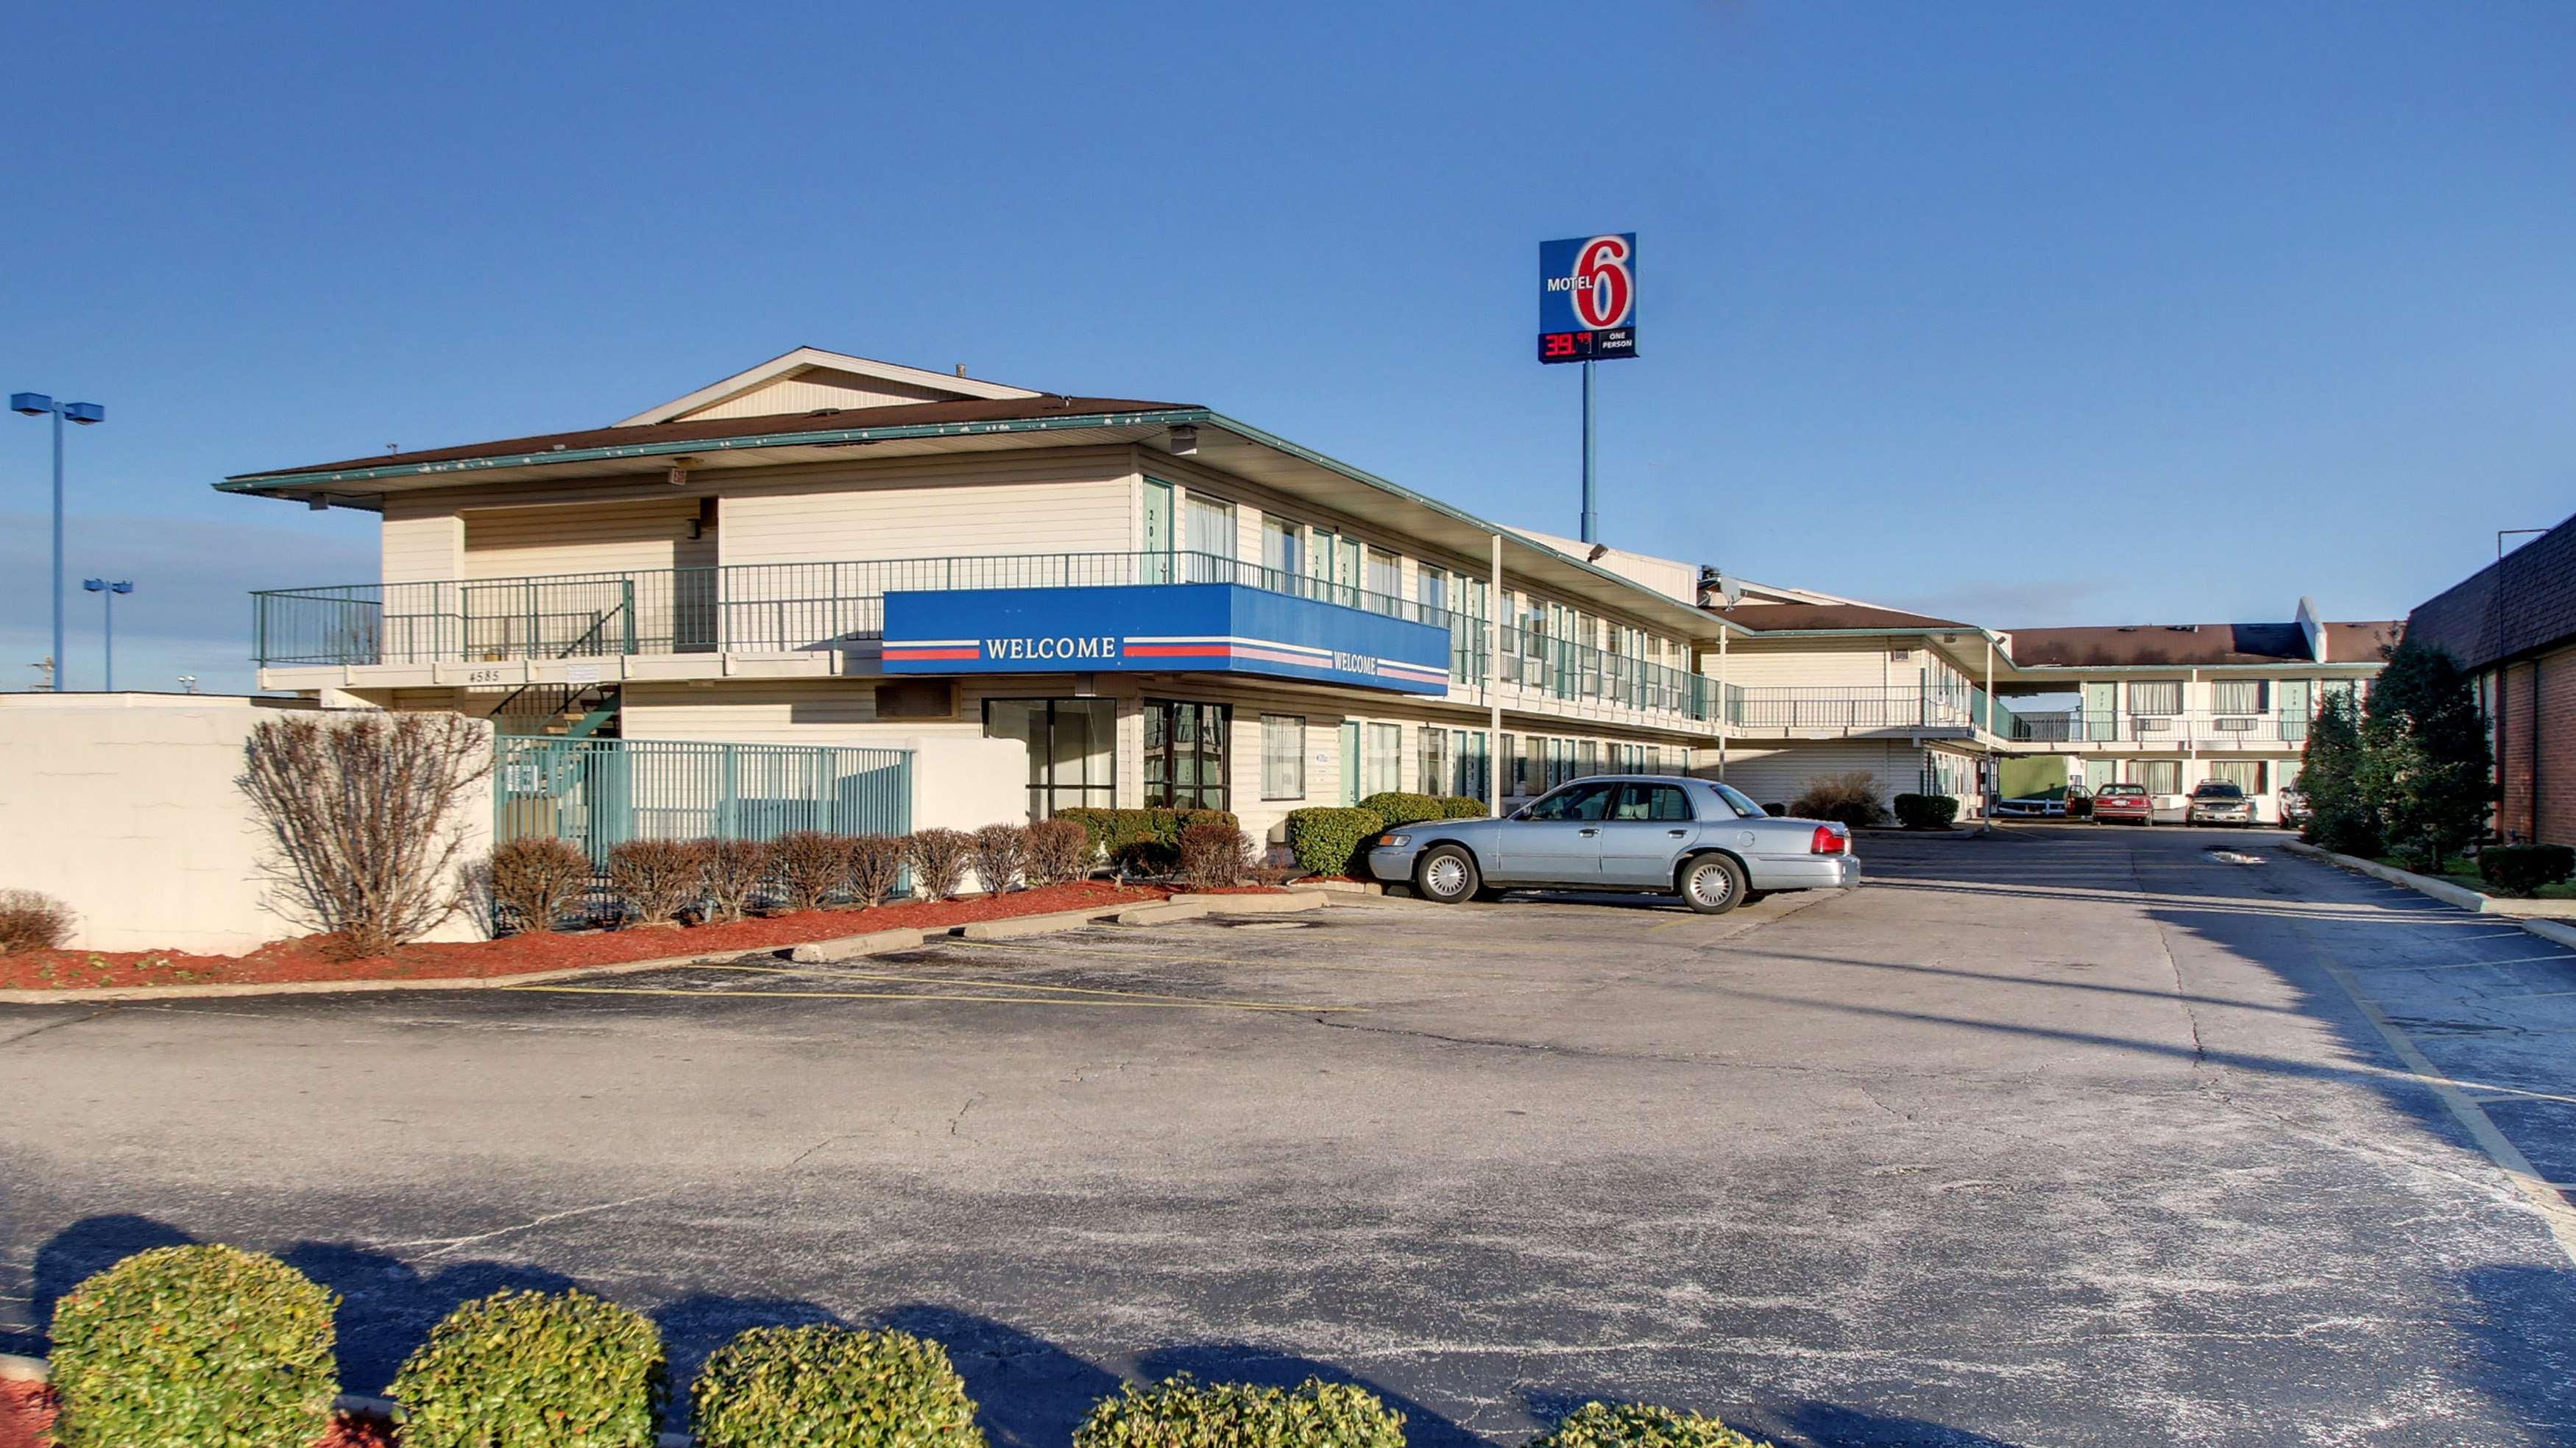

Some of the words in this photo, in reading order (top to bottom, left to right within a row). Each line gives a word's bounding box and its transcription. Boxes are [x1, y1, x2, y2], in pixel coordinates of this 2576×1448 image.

[1547, 276, 1593, 291] MOTEL
[1574, 238, 1630, 328] 6
[1602, 340, 1632, 349] PERSON
[1610, 332, 1626, 340] ONE
[986, 636, 1116, 660] WELCOME
[1334, 651, 1376, 675] WELCOME
[470, 670, 499, 683] 4585
